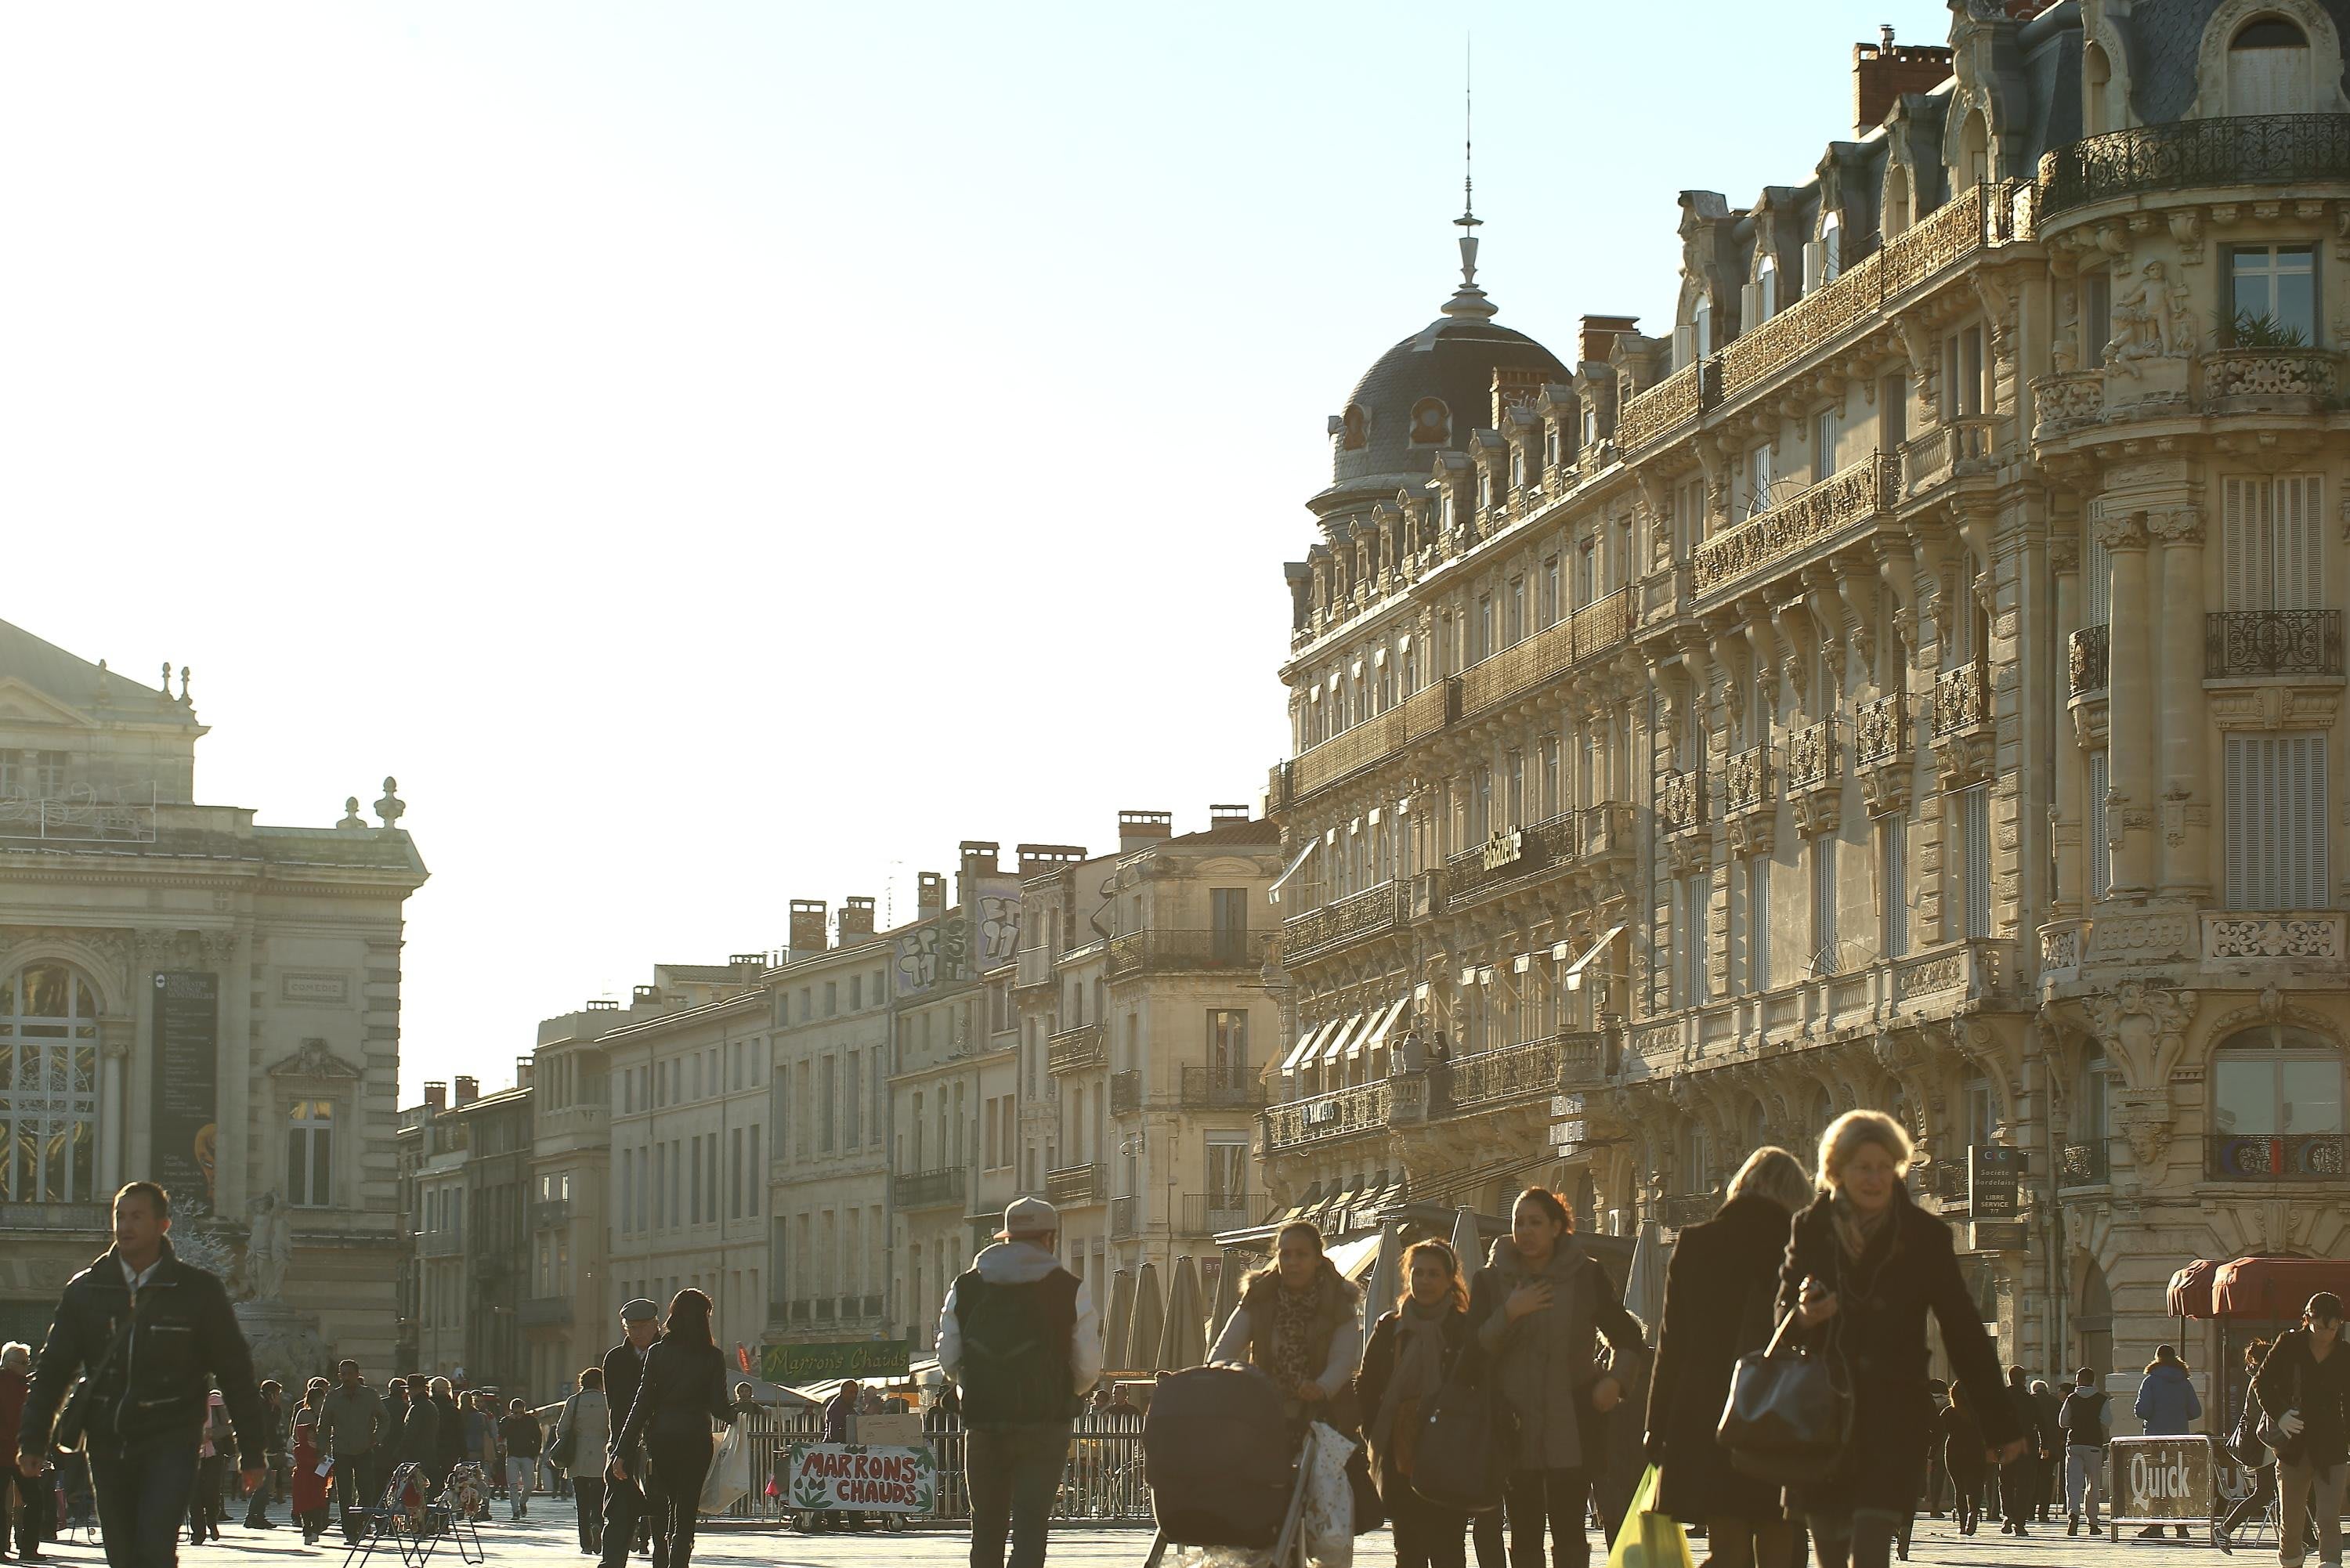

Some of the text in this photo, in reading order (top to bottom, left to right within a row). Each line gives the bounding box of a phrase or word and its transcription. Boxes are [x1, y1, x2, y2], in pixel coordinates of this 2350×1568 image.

[768, 1350, 844, 1375] Marrons
[851, 1346, 909, 1369] Chauds
[801, 1452, 916, 1483] MARRONS
[2131, 1451, 2191, 1511] Quick
[837, 1479, 916, 1506] CHAUDS
